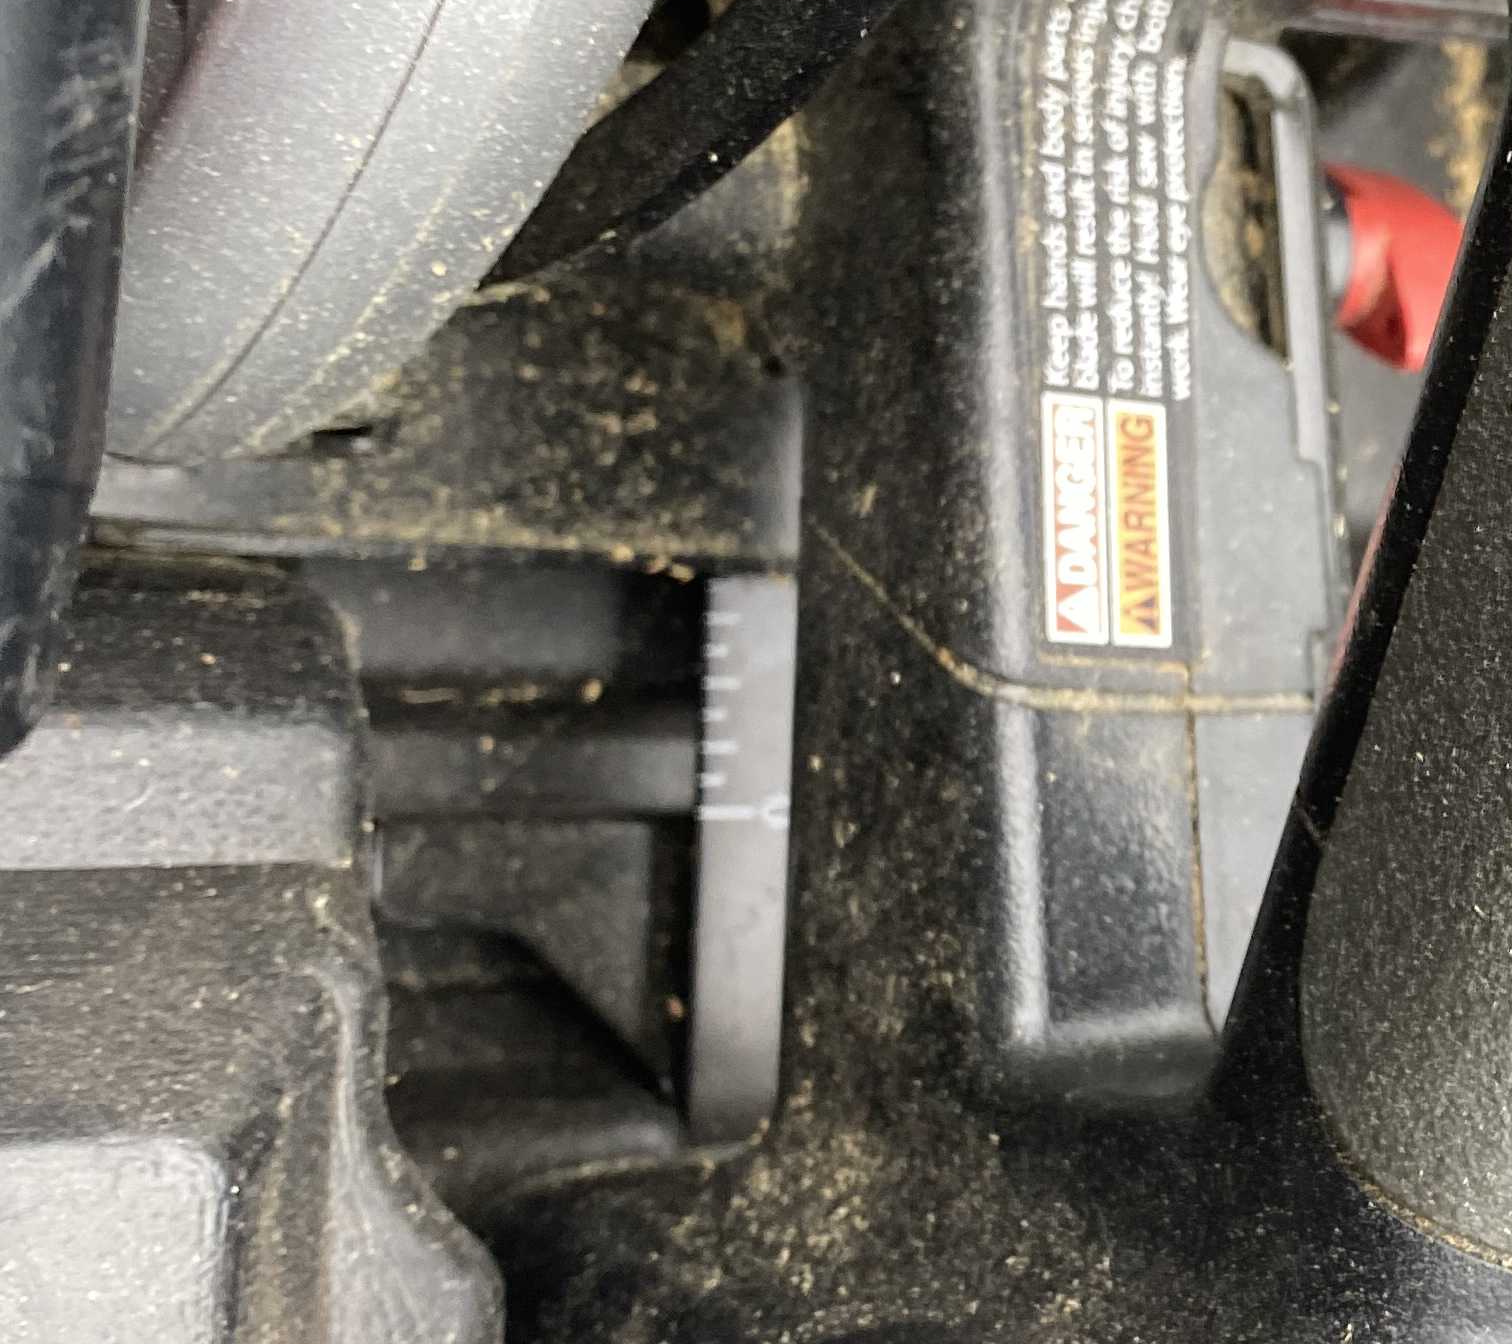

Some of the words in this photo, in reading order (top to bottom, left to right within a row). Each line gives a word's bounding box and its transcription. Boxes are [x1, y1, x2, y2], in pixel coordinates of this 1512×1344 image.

[1043, 7, 1074, 79] parts
[1039, 86, 1072, 157] body
[1072, 48, 1095, 143] serious
[1133, 62, 1157, 124] with
[1071, 149, 1094, 173] in
[1105, 121, 1129, 151] of
[1138, 136, 1158, 186] saw
[1037, 163, 1068, 217] and
[1105, 158, 1130, 204] risk
[1070, 176, 1096, 254] result
[1105, 209, 1130, 254] the
[1133, 198, 1160, 263] Hold
[1170, 205, 1192, 252] eye
[1040, 224, 1068, 308] hands
[1072, 261, 1096, 307] will
[1167, 258, 1188, 323] Wear
[1107, 261, 1133, 354] reduce
[1042, 318, 1072, 386] Keep
[1072, 313, 1098, 389] blade
[1109, 361, 1133, 394] To
[1057, 406, 1098, 572] DANGER
[1118, 415, 1161, 595] WARNING
